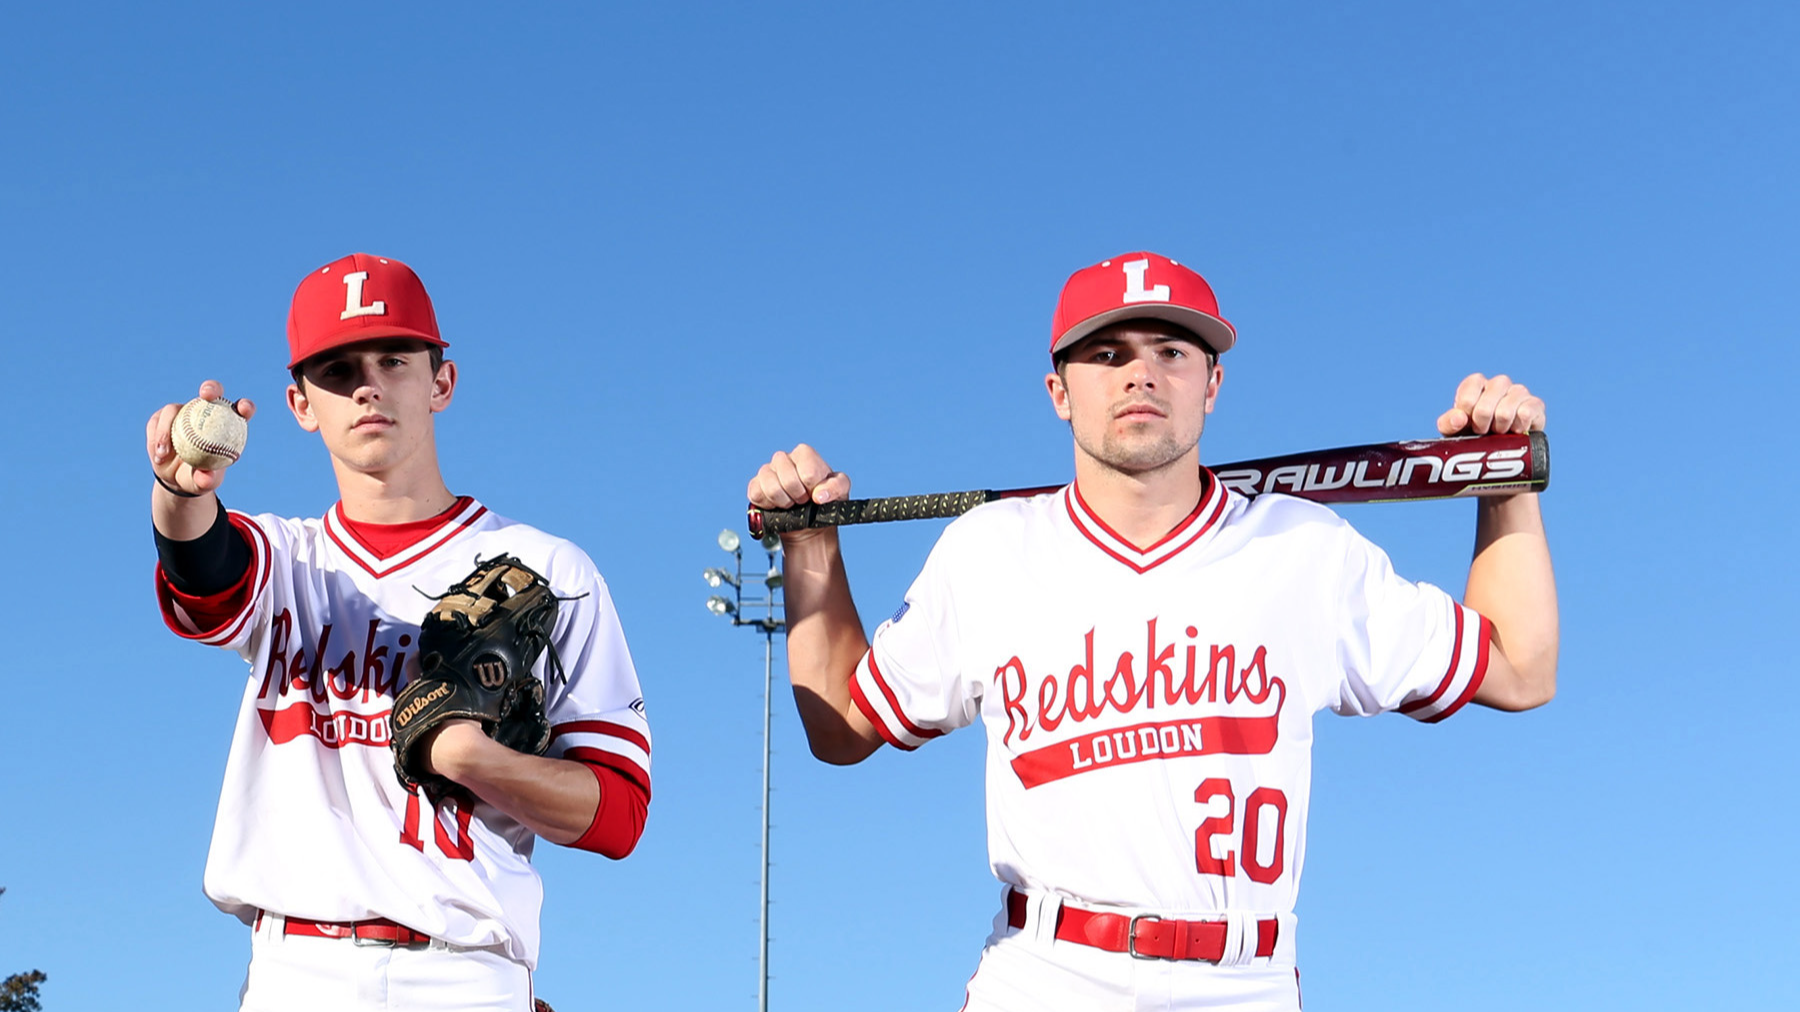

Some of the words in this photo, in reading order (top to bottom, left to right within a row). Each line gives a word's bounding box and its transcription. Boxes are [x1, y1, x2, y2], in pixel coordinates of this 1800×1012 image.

[339, 271, 385, 320] L
[1122, 259, 1171, 303] L
[1218, 446, 1528, 494] RAWLINGS
[396, 682, 450, 727] Wilson
[994, 615, 1272, 749] Redskins
[1070, 723, 1203, 770] LOUDON
[1193, 777, 1288, 885] 20
